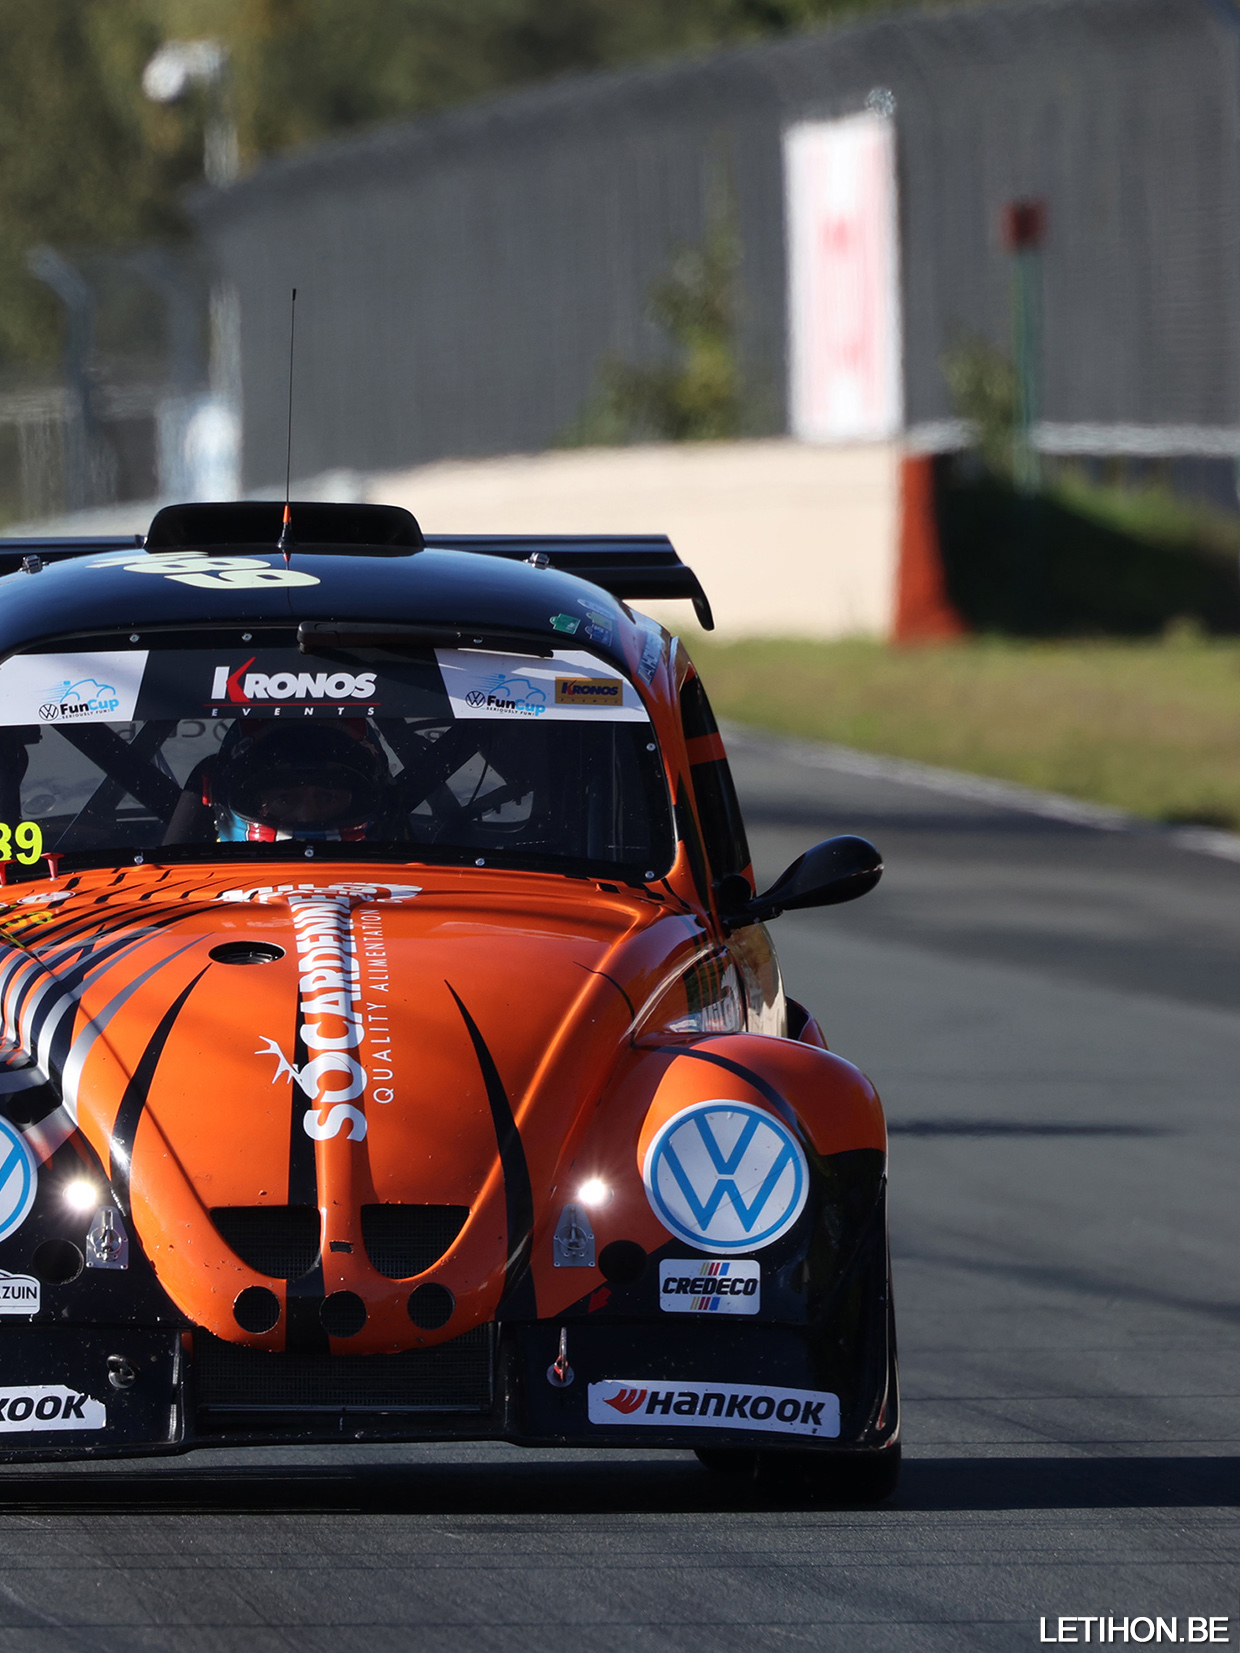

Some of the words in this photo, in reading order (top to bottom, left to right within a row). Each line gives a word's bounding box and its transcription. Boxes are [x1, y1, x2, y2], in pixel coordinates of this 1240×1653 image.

[211, 656, 378, 702] KRONOS
[561, 679, 619, 696] KRONOS
[60, 698, 119, 715] FunCup
[211, 706, 375, 717] EVENTS
[487, 694, 546, 716] FunCup
[359, 908, 390, 992] ALIMENTATION
[288, 895, 368, 1142] SOCARDENNE
[366, 1001, 394, 1104] QUALITY
[662, 1277, 759, 1296] CREDECO
